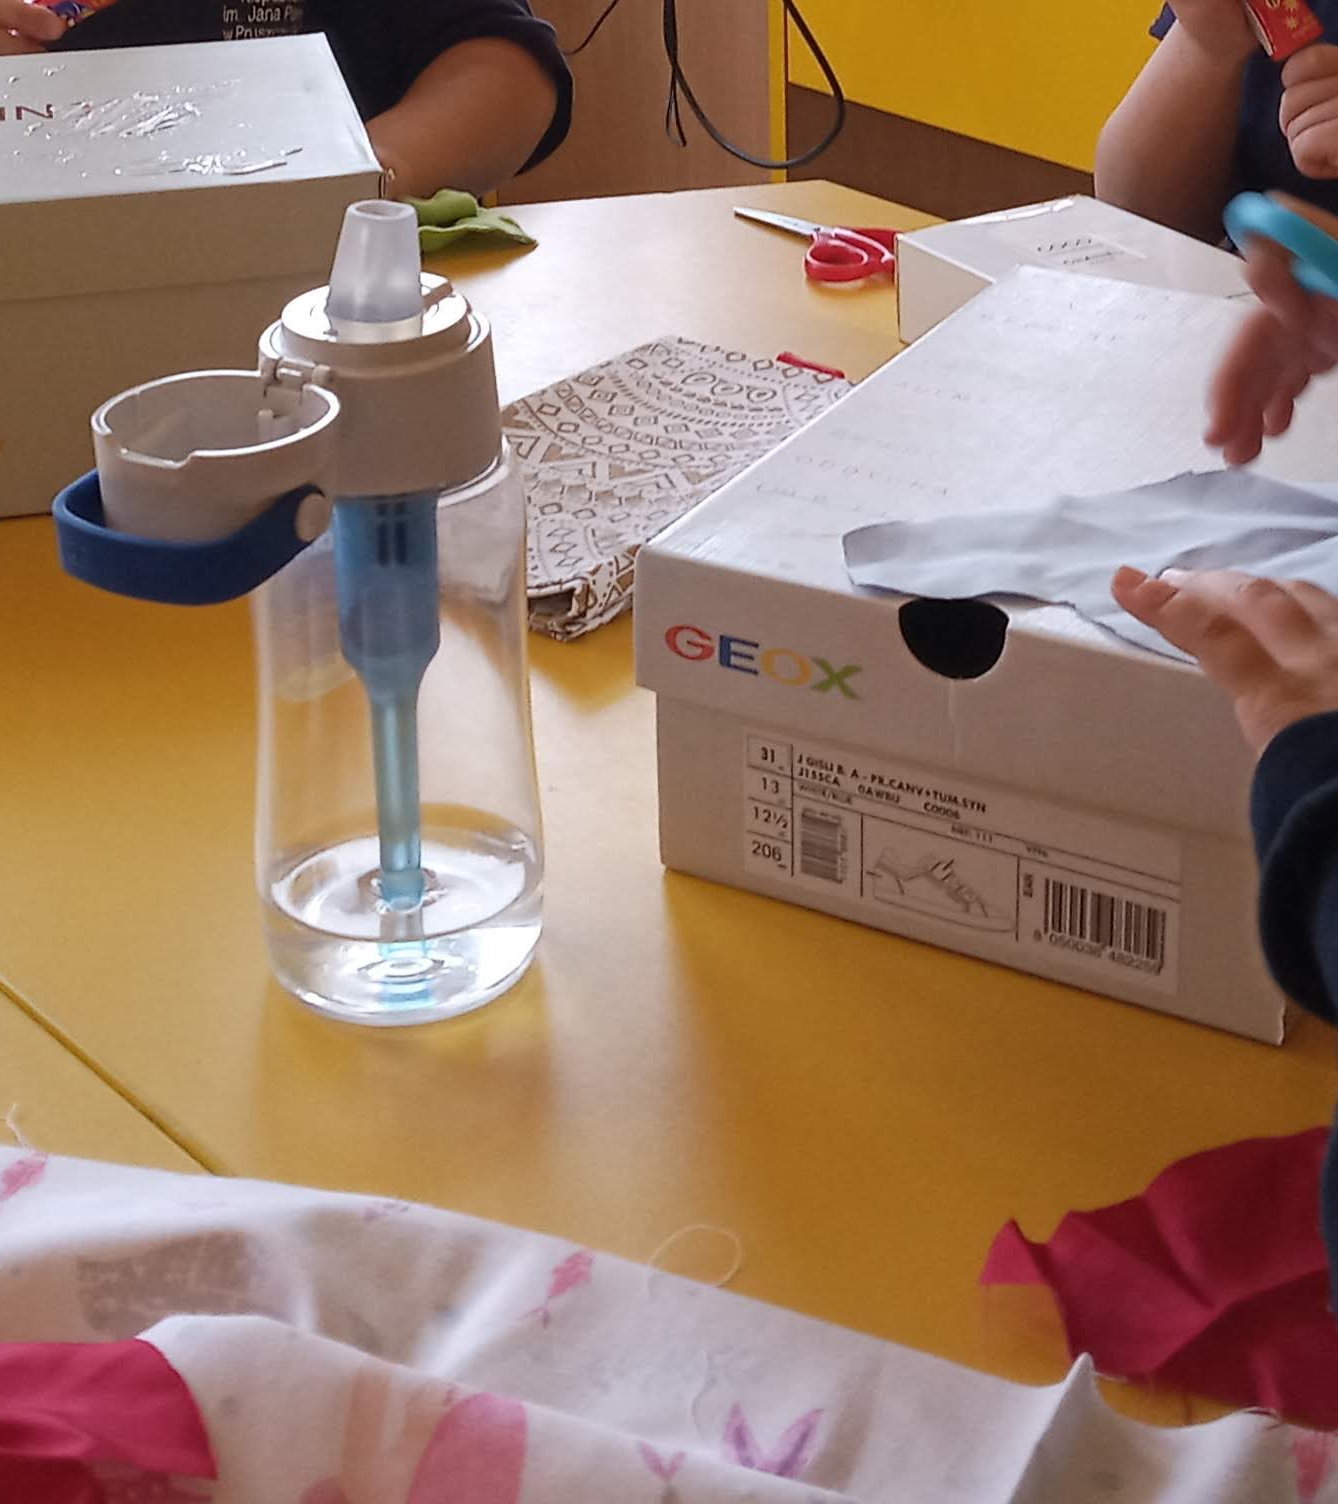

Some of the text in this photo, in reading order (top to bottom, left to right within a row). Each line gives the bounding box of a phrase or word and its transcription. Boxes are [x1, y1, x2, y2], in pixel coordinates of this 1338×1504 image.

[247, 5, 281, 23] Jana
[664, 623, 863, 700] GEOX
[761, 776, 779, 795] 13
[751, 840, 782, 863] 206
